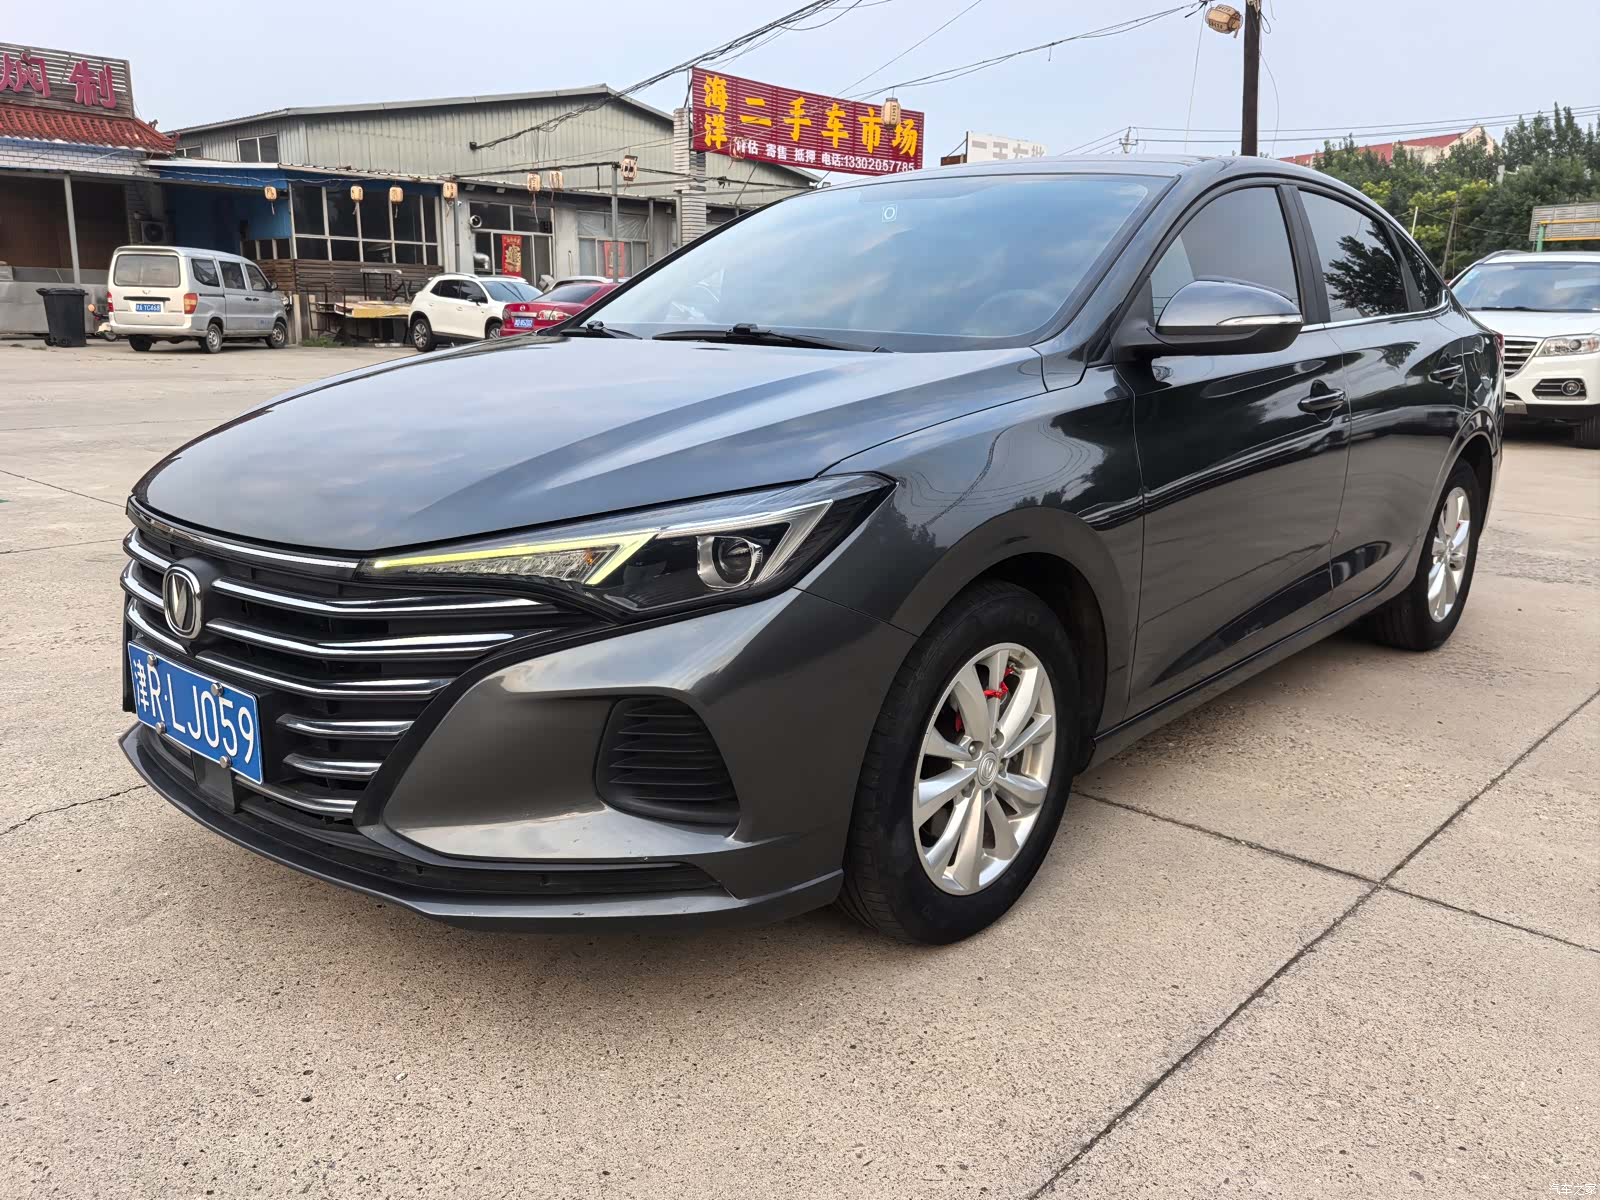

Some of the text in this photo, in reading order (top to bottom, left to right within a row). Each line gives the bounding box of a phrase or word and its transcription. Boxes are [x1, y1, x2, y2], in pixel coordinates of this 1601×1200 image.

[703, 74, 729, 150] 海洋
[739, 96, 918, 157] 二手车市场
[766, 143, 787, 160] 寄售
[795, 147, 816, 164] 抵押
[133, 659, 254, 764] 津R·LJ059
